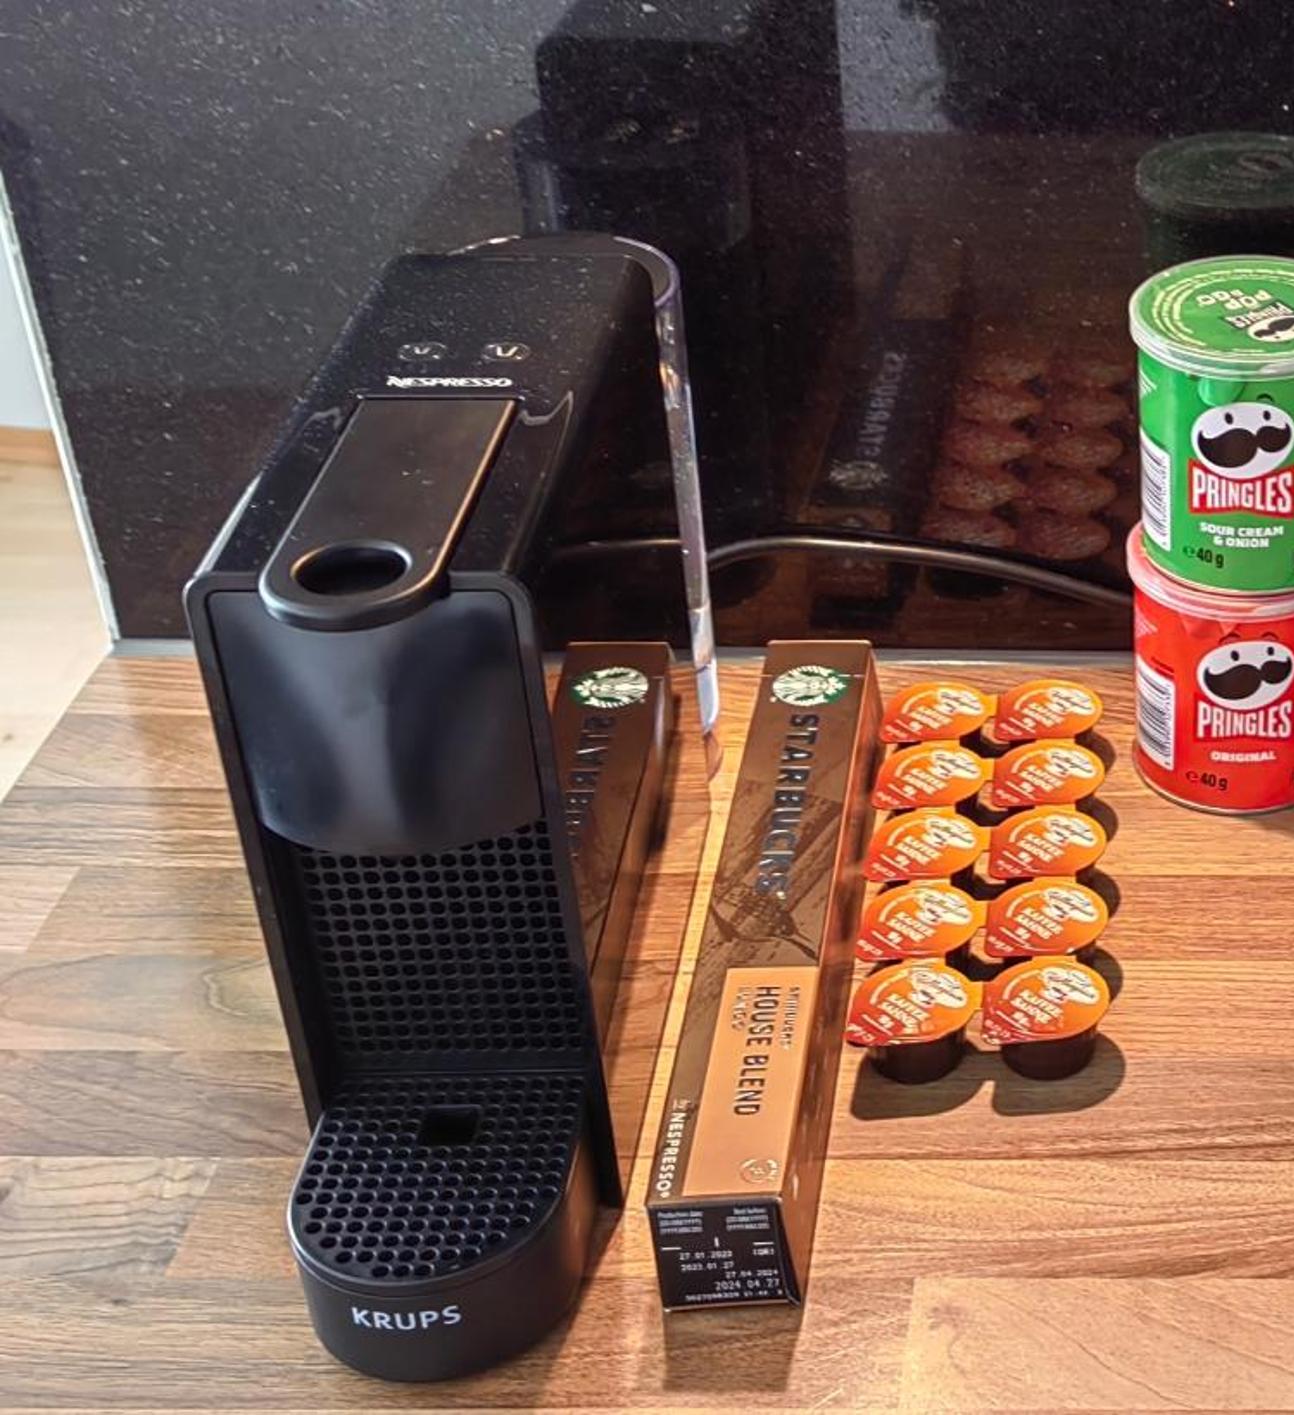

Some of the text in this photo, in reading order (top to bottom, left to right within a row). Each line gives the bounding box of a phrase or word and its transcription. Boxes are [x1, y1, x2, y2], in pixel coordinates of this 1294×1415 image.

[386, 375, 513, 389] NESPRESSO
[1192, 465, 1294, 513] PRINGLES
[1199, 522, 1284, 537] SOUR CREAM
[1225, 537, 1270, 548] ONION
[1196, 700, 1293, 740] PRINGLES
[1209, 750, 1277, 762] ORIGINAL
[754, 713, 820, 894] STARBUCKS
[745, 986, 781, 1047] HOUSE
[733, 1055, 770, 1116] BLEND
[351, 1305, 463, 1331] KRUPS
